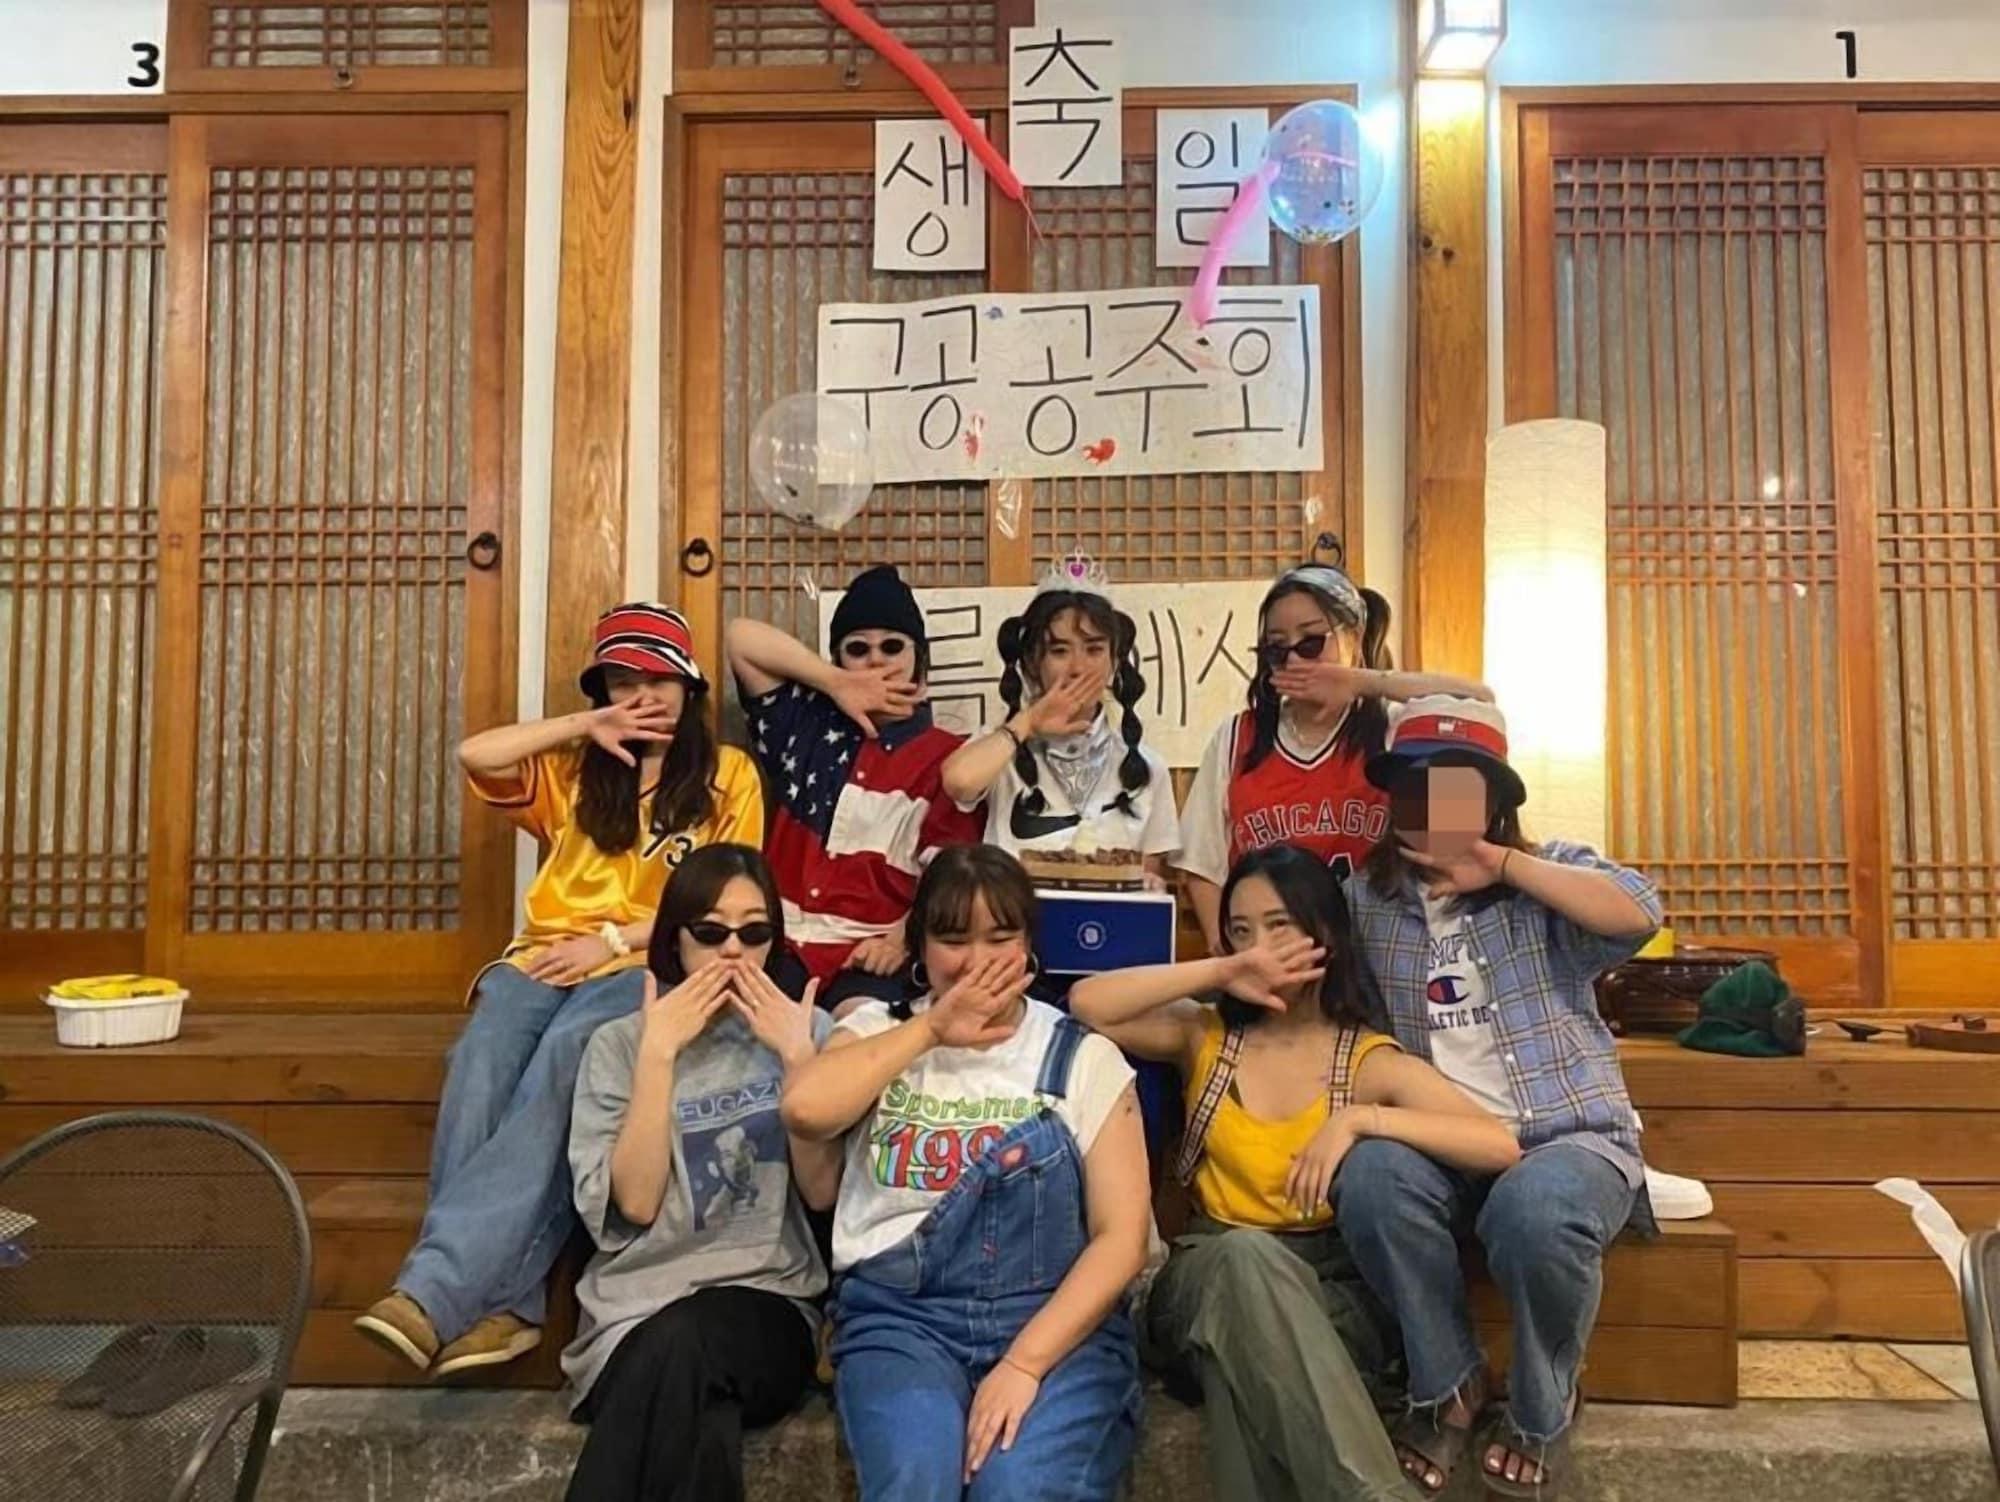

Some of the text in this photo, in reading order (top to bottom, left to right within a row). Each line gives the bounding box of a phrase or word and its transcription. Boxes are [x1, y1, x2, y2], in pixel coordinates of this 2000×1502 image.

[128, 42, 160, 88] 3
[1836, 31, 1857, 78] 1
[1013, 28, 1113, 180] 축
[882, 135, 968, 257] 생
[1175, 121, 1240, 246] 일
[1235, 798, 1389, 851] CHICAGO
